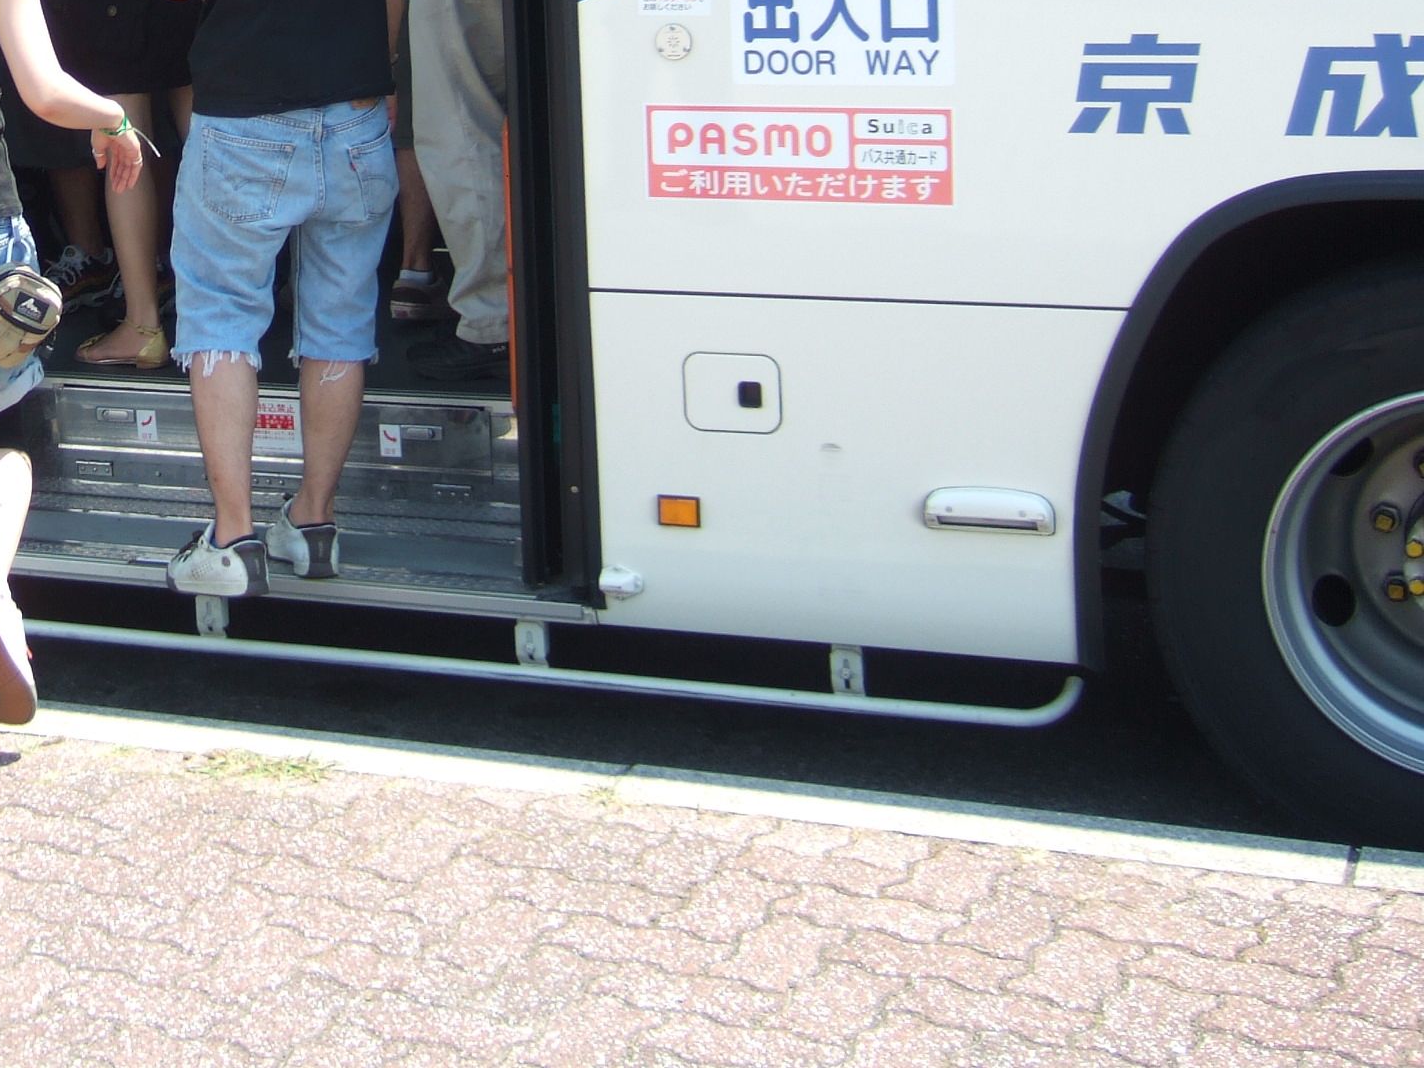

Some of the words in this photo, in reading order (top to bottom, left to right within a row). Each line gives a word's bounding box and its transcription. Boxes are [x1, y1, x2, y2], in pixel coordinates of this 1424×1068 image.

[744, 49, 836, 76] DOOR
[865, 49, 939, 76] WAY
[667, 122, 833, 158] PASMO
[867, 118, 933, 135] Suica
[862, 148, 938, 166] バス共通カード
[660, 168, 941, 201] ご利用いただけます
